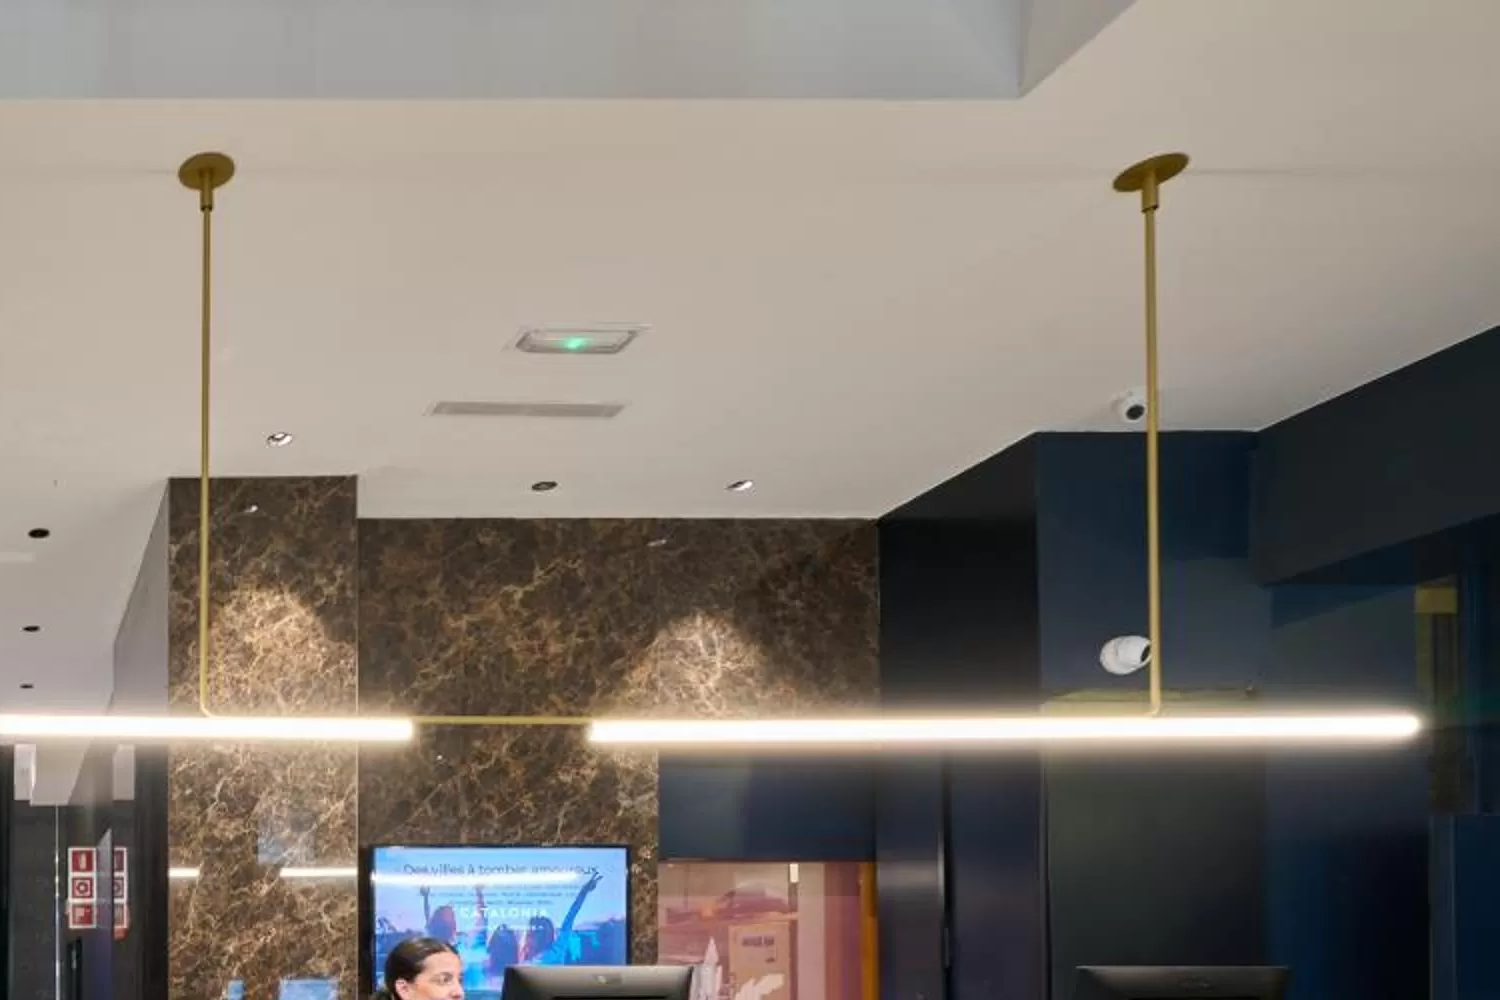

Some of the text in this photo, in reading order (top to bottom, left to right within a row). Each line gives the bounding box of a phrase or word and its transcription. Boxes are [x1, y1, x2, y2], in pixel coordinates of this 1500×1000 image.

[403, 863, 429, 875] Des
[431, 863, 465, 876] villes
[467, 863, 476, 875] à
[478, 863, 528, 876] tomber
[459, 906, 548, 919] CATALONIA
